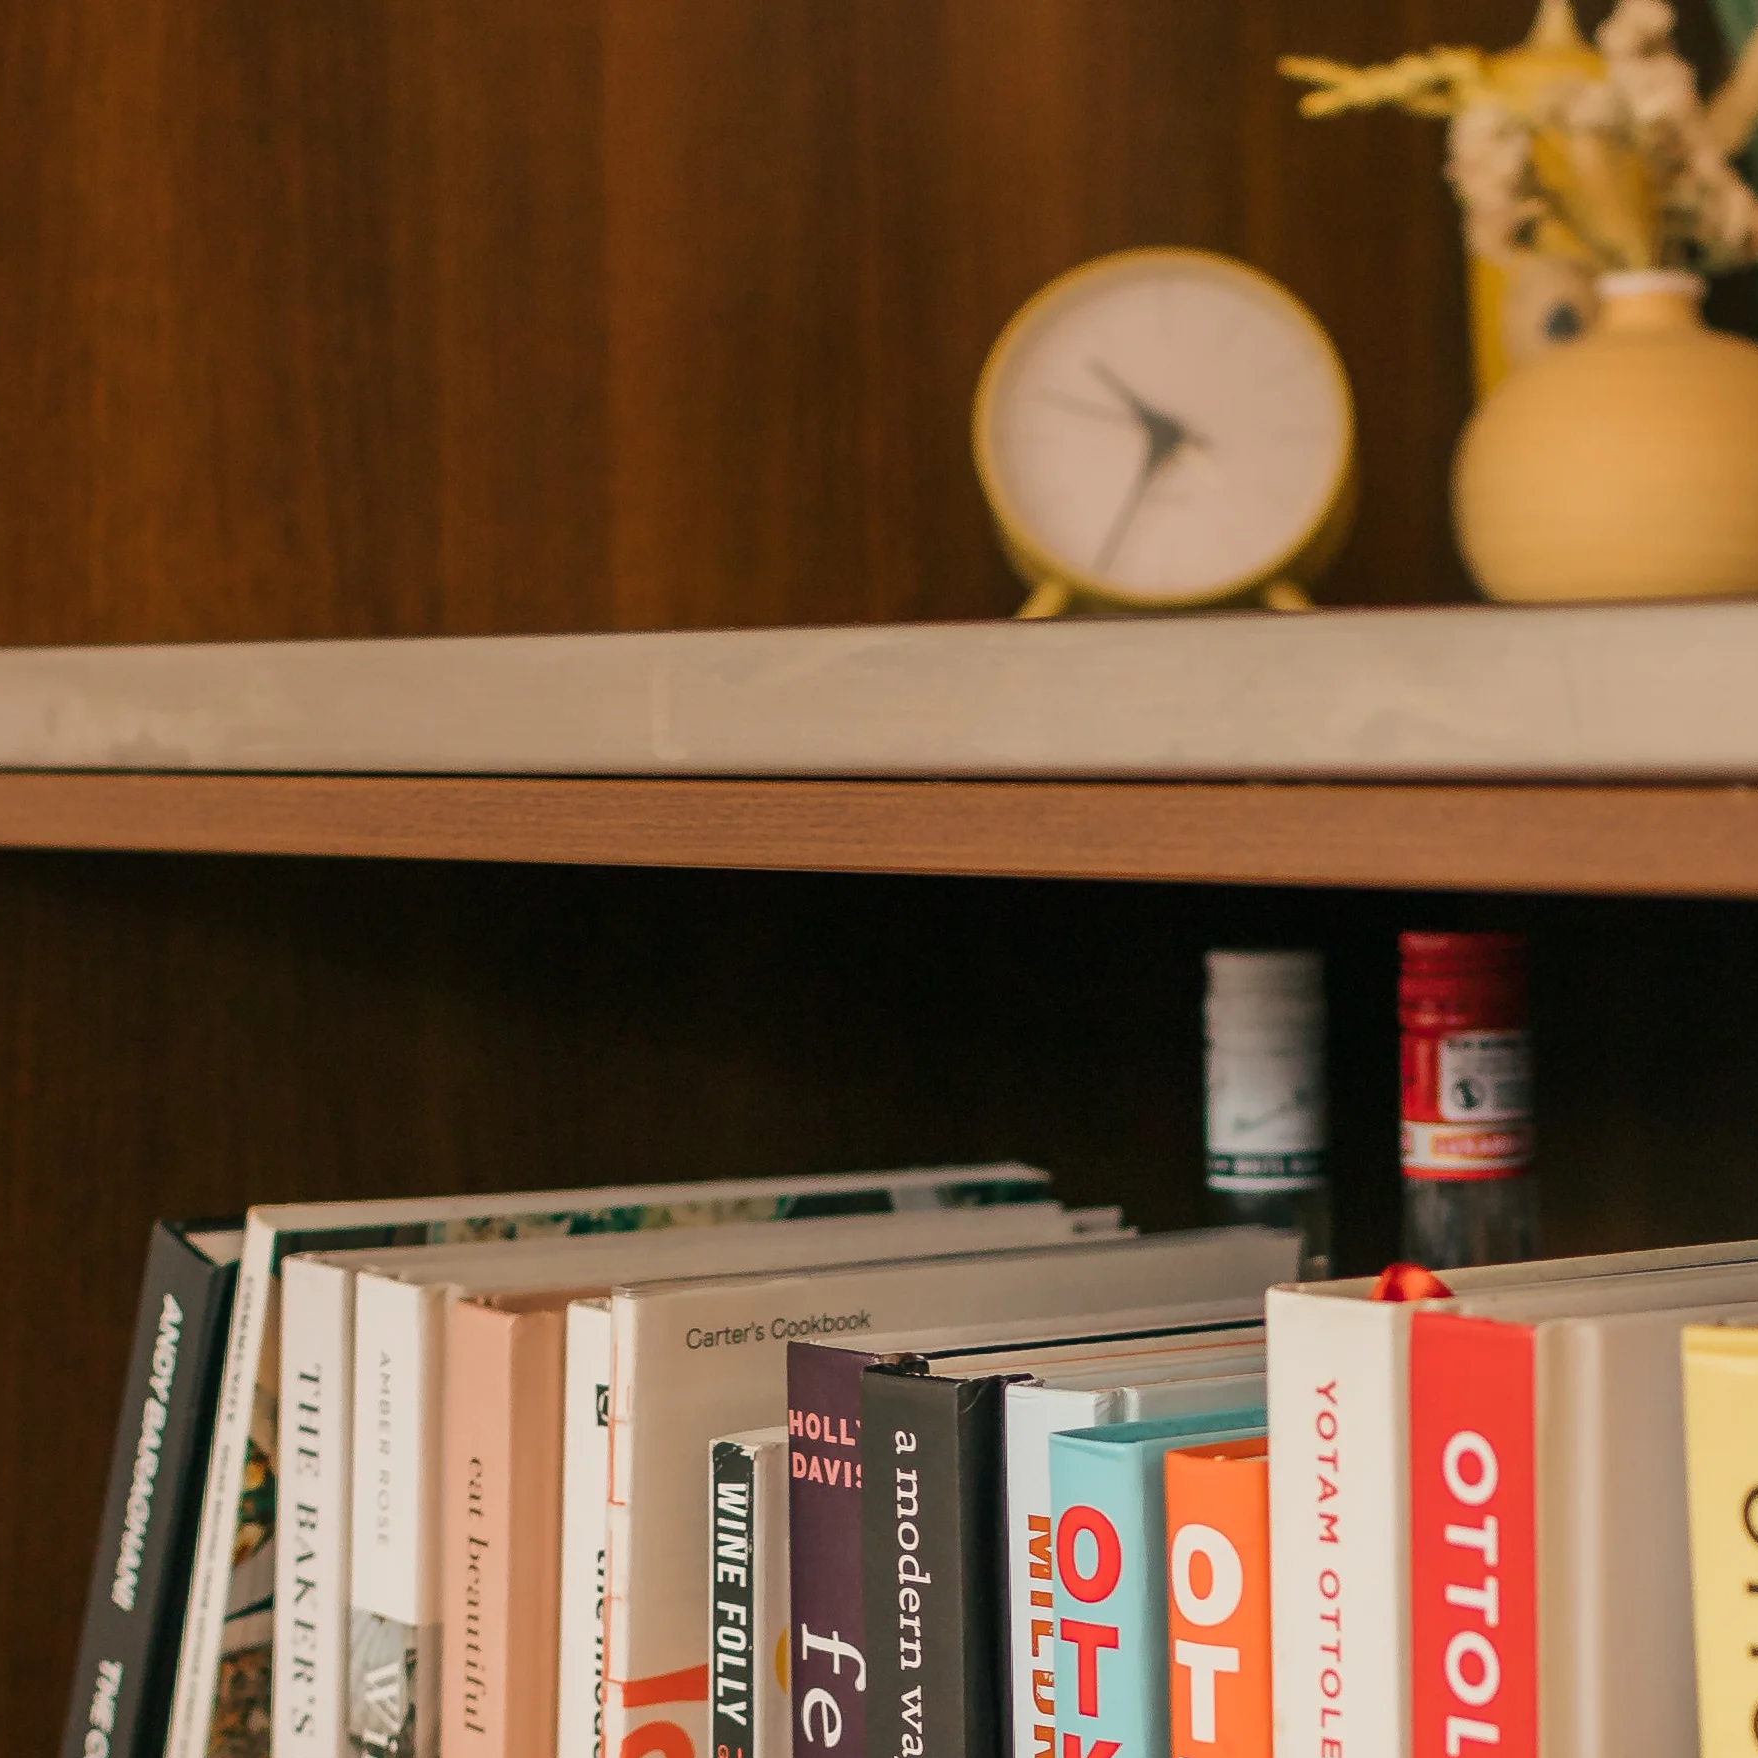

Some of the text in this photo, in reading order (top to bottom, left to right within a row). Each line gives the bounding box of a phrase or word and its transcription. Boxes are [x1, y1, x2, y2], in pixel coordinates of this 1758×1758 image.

[151, 1291, 184, 1400] ANDY
[686, 1309, 872, 1350] Carter's Cookbook
[297, 1363, 323, 1478] THE
[788, 1409, 861, 1447] HOLL
[895, 1430, 917, 1455] a
[1314, 1379, 1339, 1543] YOTAM
[289, 1503, 320, 1738] BAKER'S
[463, 1457, 491, 1735] eat beautiful
[716, 1481, 749, 1726] WINE FOLLY
[896, 1468, 931, 1671] modern
[87, 1660, 124, 1730] THE
